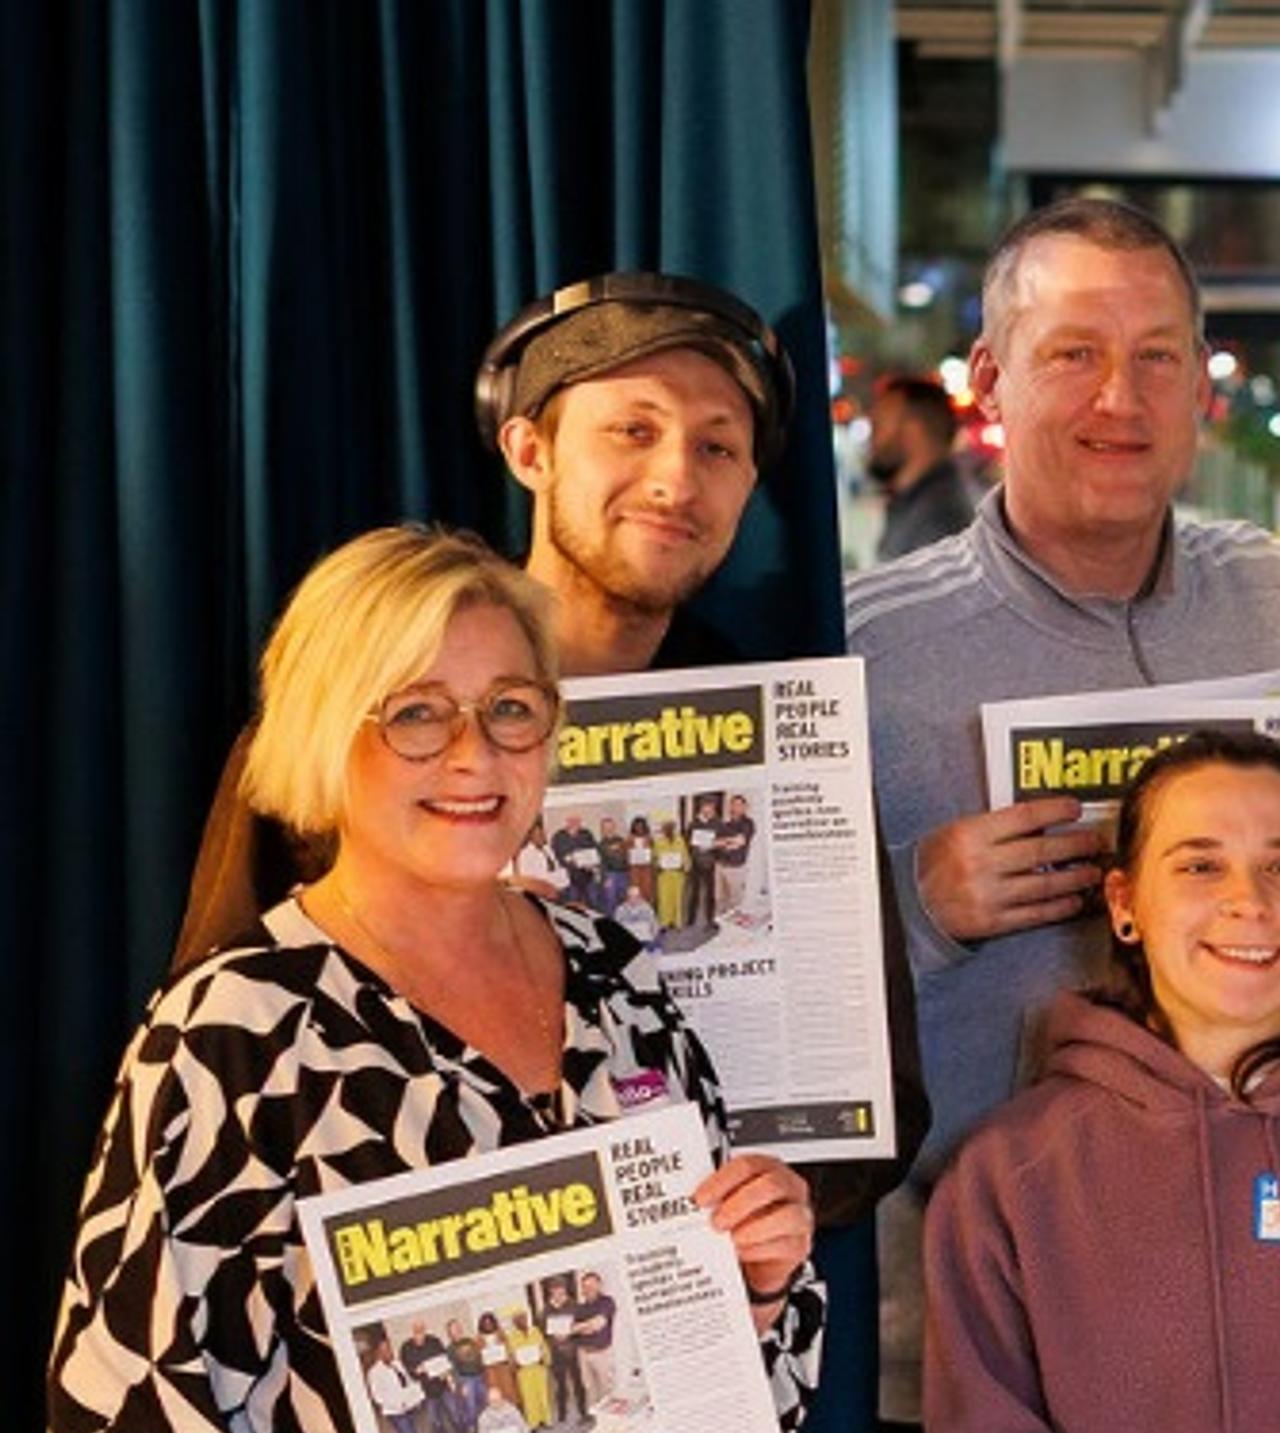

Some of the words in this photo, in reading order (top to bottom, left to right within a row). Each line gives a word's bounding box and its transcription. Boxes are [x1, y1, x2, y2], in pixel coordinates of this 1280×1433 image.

[774, 680, 815, 697] REAL
[775, 699, 839, 719] PEOPLE
[558, 707, 753, 768] arrative
[776, 722, 818, 739] REAL
[778, 741, 849, 761] STORIES
[707, 958, 776, 979] PROJECT
[610, 1135, 655, 1162] REAL
[614, 1151, 683, 1184] PEOPLE
[620, 1180, 666, 1206] REAL
[626, 1195, 700, 1228] STORIES
[345, 1183, 599, 1282] Narrative
